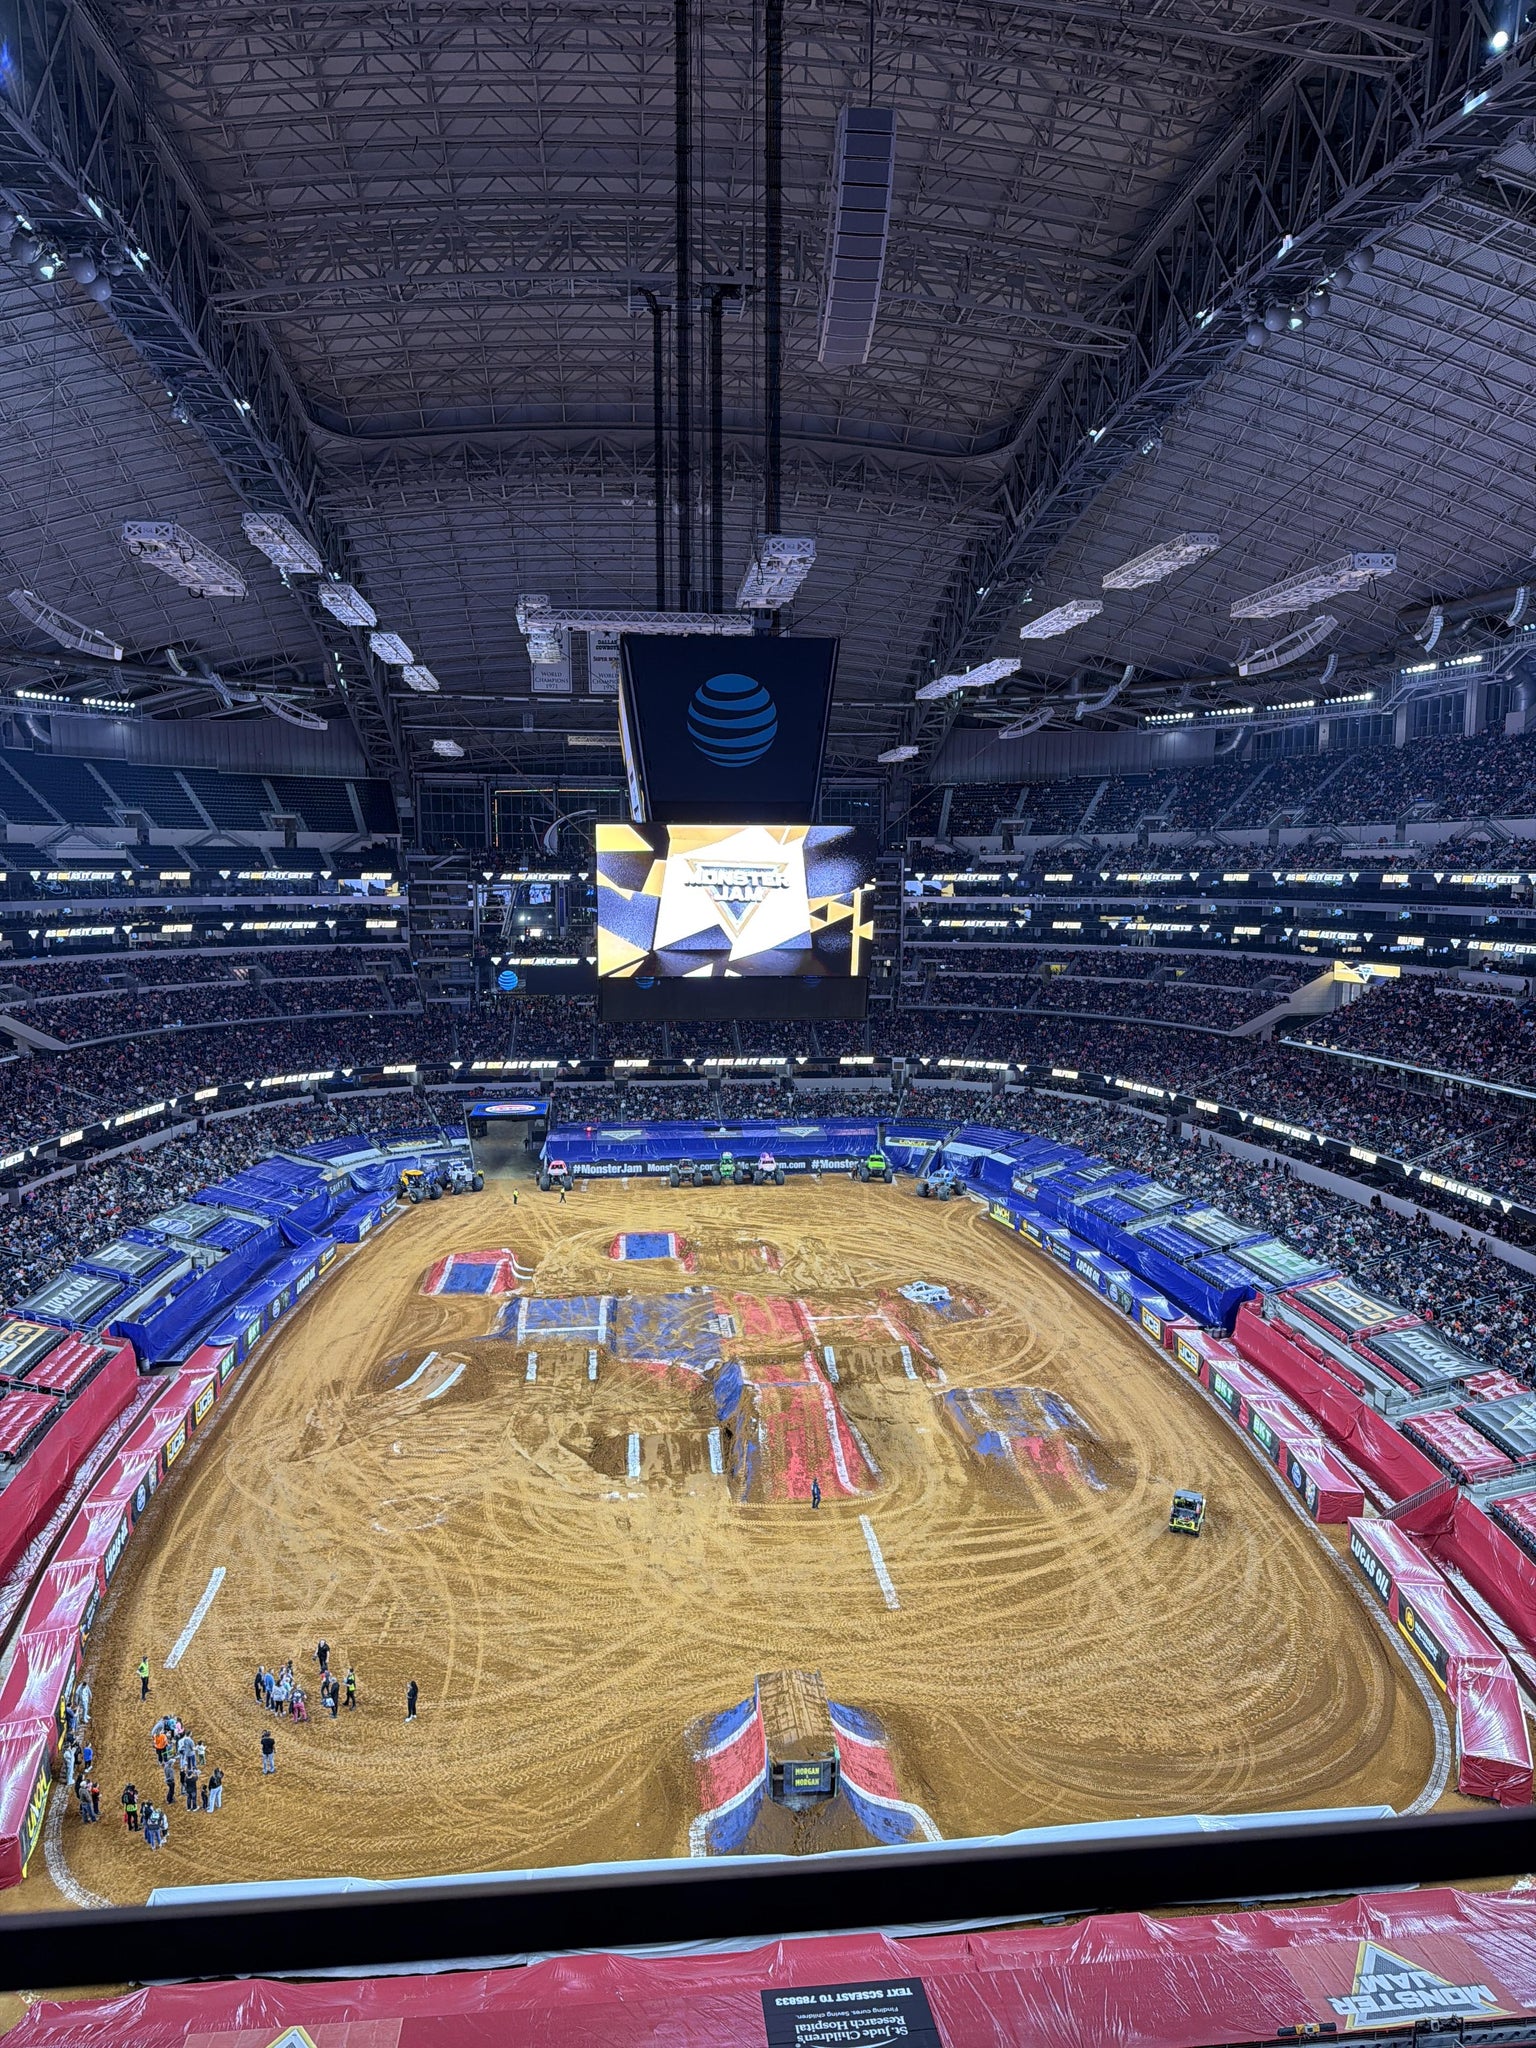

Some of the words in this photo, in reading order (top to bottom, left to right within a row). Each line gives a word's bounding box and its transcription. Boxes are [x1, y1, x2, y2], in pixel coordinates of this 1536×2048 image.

[714, 886, 762, 902] JAM
[573, 1163, 642, 1174] #MonsterJam
[40, 1286, 78, 1314] LUCAS
[75, 1276, 100, 1292] OIL
[1318, 1284, 1362, 1309] JCB
[1181, 1345, 1197, 1368] JCB
[1214, 1374, 1233, 1404] BKT
[1253, 1414, 1271, 1447] BKT
[1351, 1534, 1376, 1579] LUCAS
[1375, 1569, 1391, 1602] OIL
[795, 1778, 820, 1786] MORGAN
[1359, 1971, 1437, 1993] JAM
[819, 1994, 834, 2002] TO
[836, 1990, 884, 2002] SCSEAST
[887, 1987, 913, 1997] TEXT
[775, 1995, 817, 2006] 785833
[1328, 1984, 1498, 2015] MONSTER
[826, 2009, 850, 2017] Saving
[795, 2021, 848, 2032] Hospital
[851, 2016, 906, 2027] Research
[797, 2030, 861, 2043] Children's
[862, 2028, 891, 2038] Jude
[892, 2026, 909, 2035] St.
